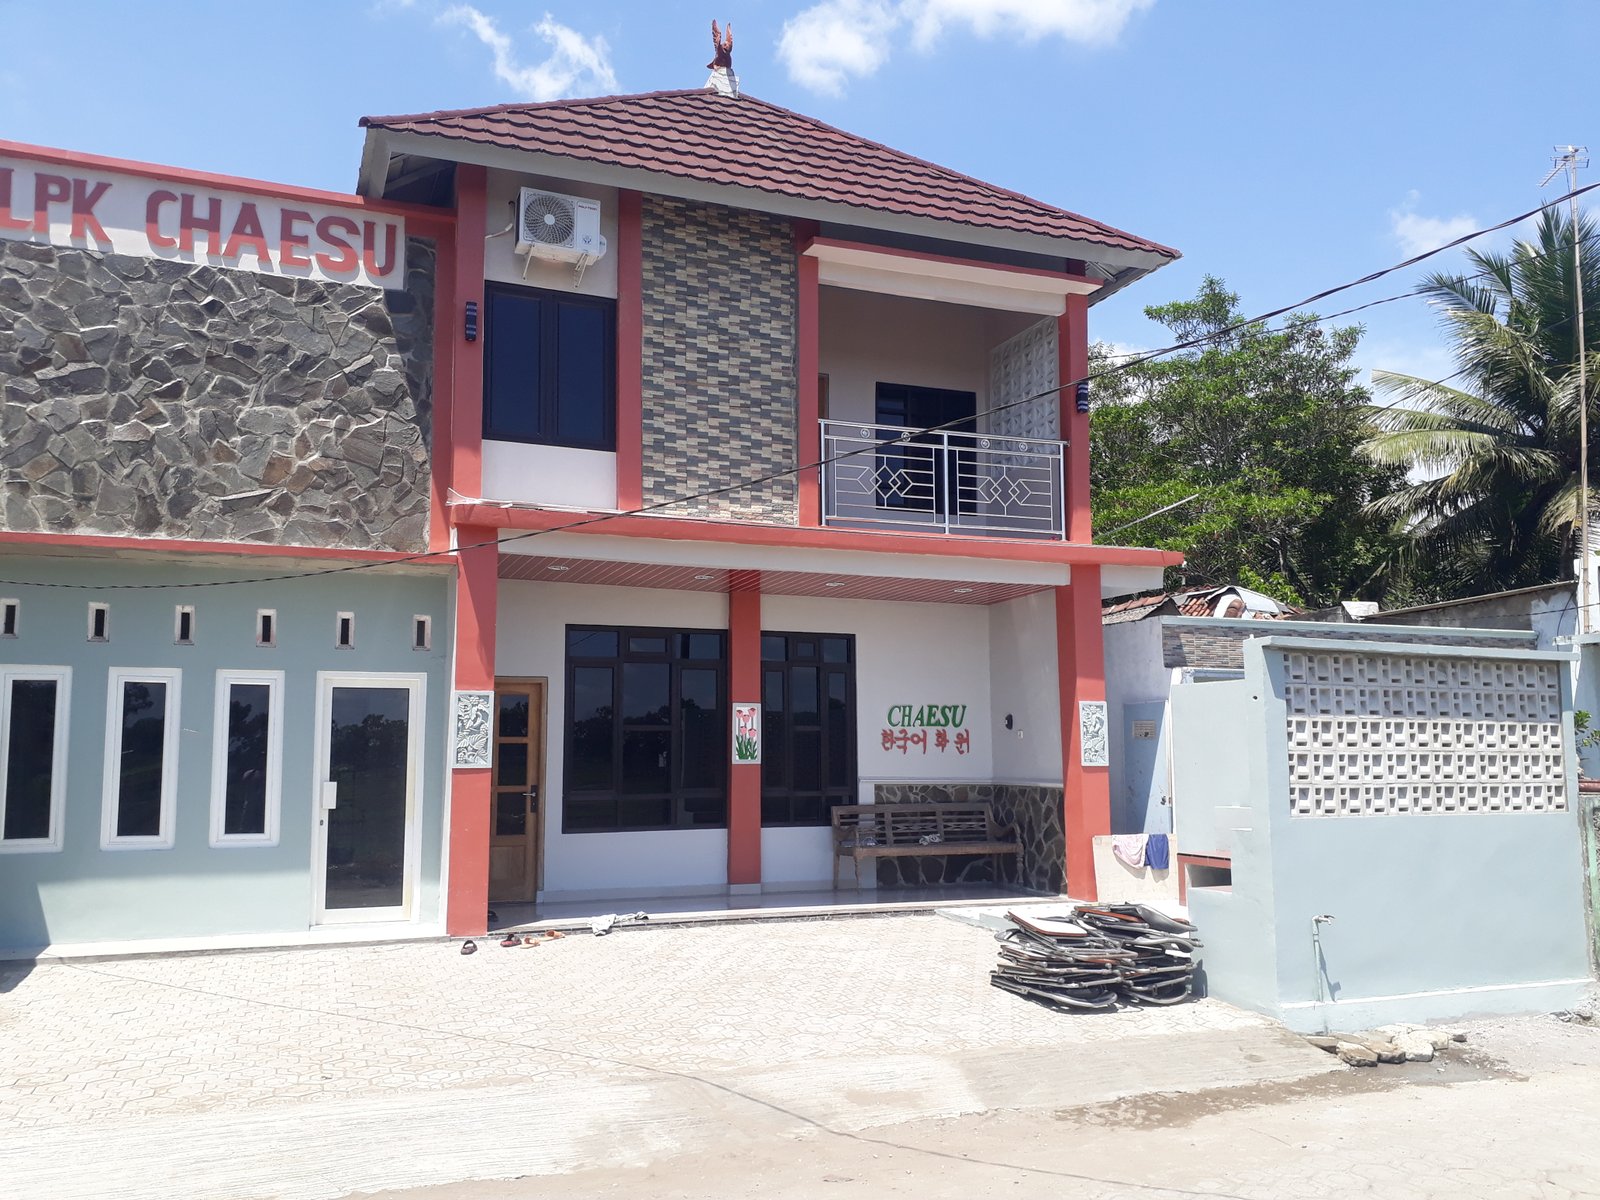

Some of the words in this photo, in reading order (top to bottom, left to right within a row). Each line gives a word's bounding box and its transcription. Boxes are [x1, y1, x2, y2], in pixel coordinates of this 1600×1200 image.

[0, 168, 113, 243] LPK
[146, 190, 397, 277] CHAESU
[887, 704, 967, 728] CHAESU
